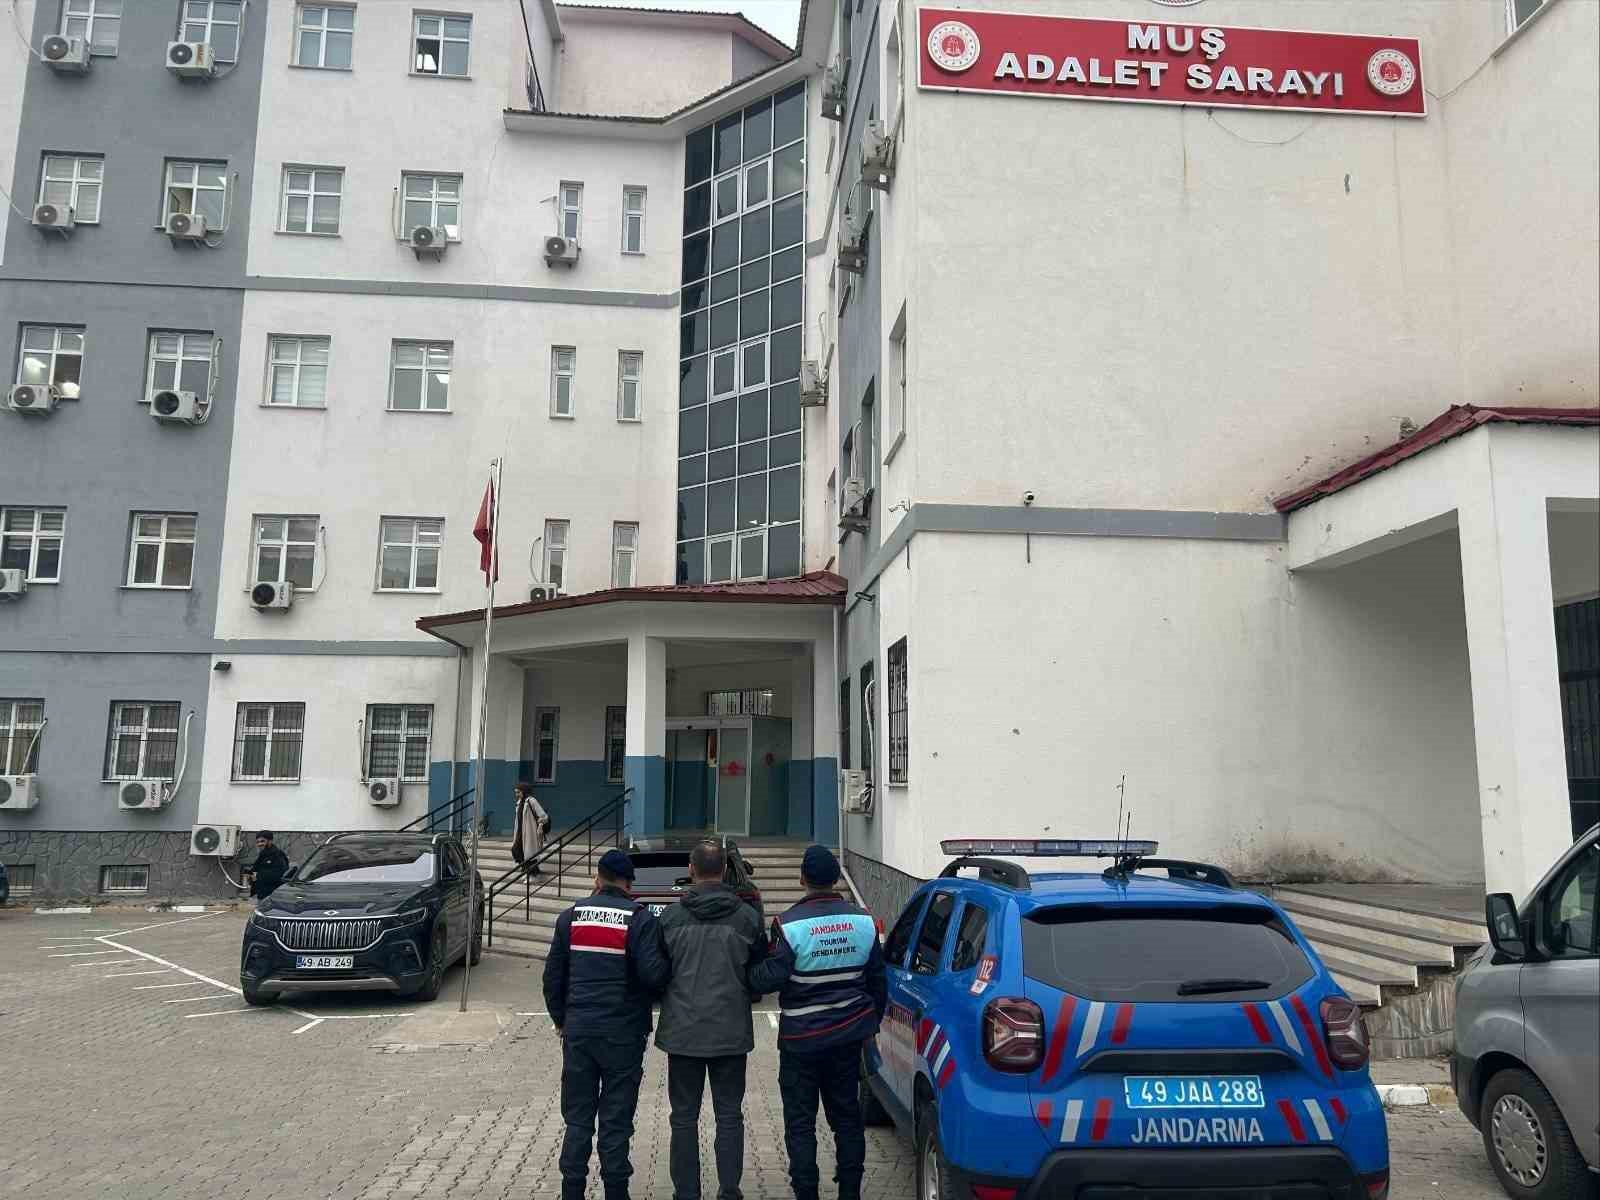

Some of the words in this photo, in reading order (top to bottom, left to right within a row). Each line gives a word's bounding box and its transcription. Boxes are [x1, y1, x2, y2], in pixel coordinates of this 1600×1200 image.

[1128, 24, 1226, 60] MUŞ
[994, 52, 1168, 88] ADALET
[1187, 63, 1344, 97] SARAYI
[576, 909, 625, 925] JANDARMA
[810, 922, 854, 936] JANDARMA
[301, 958, 313, 967] 49
[318, 957, 331, 967] AB
[335, 957, 352, 967] 249
[979, 958, 995, 979] 112
[1141, 1081, 1167, 1103] 49
[1175, 1081, 1215, 1103] JAA
[1218, 1080, 1258, 1103] 288
[1130, 1117, 1265, 1143] JANDARMA
